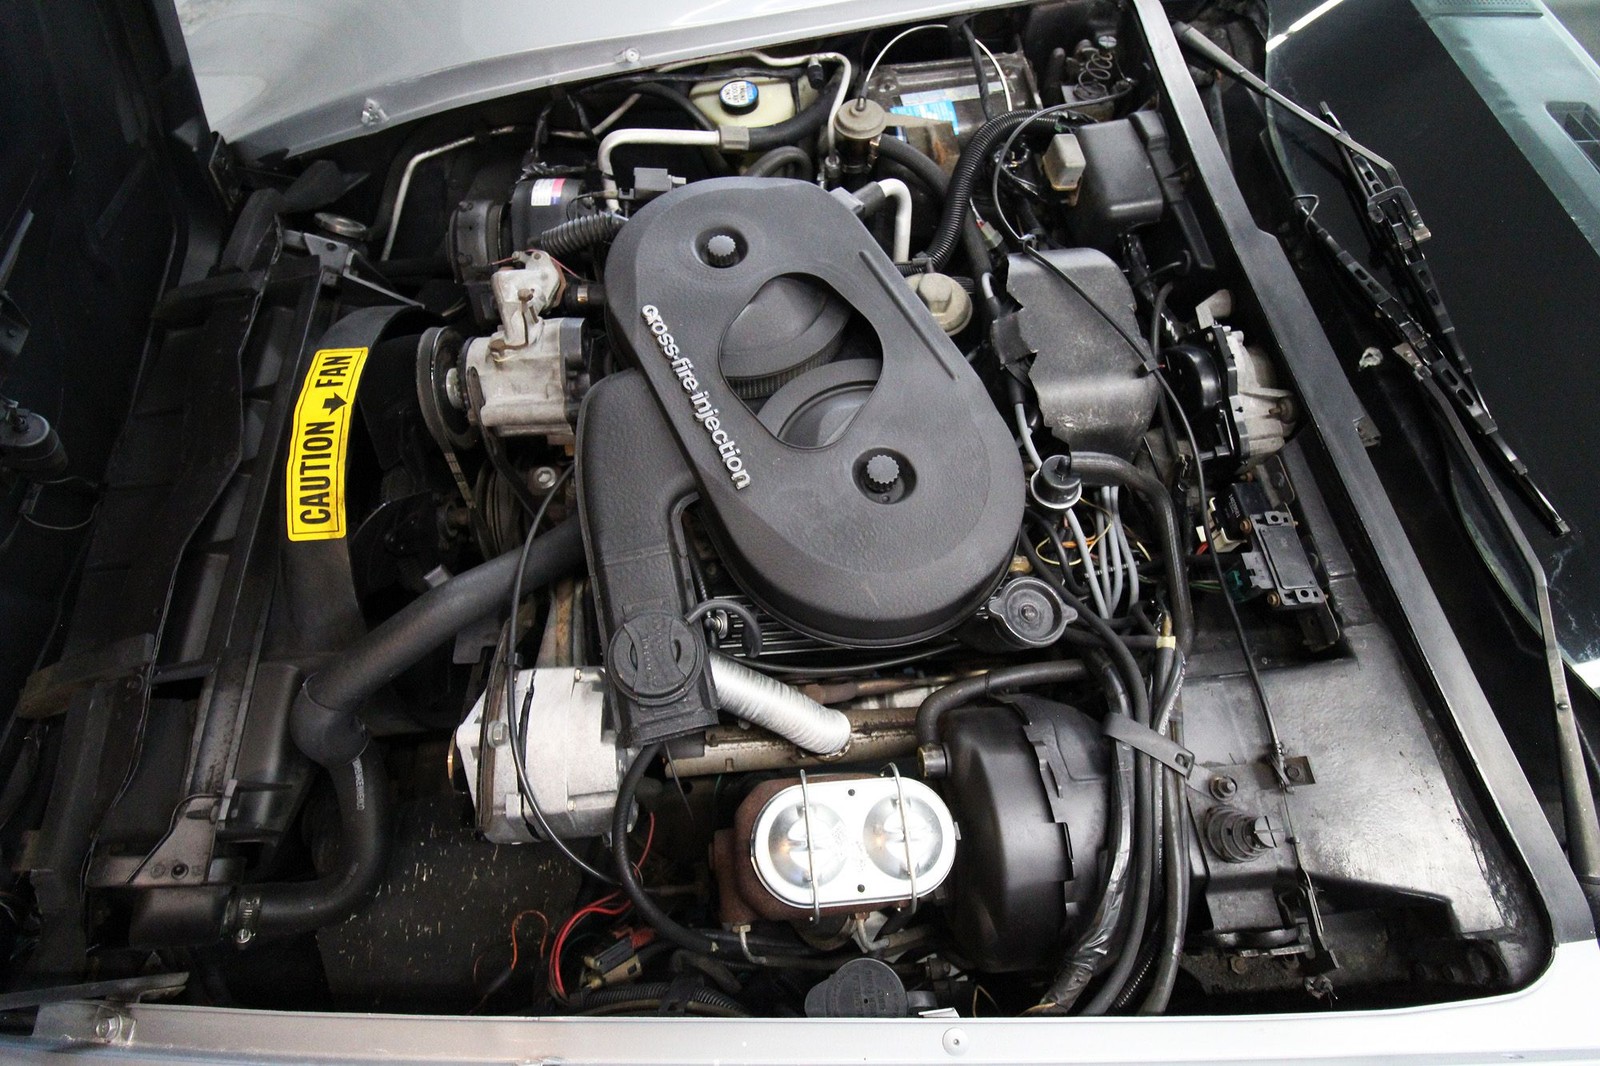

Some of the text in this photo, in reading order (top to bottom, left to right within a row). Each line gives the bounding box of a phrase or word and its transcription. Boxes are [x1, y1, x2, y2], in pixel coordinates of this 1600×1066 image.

[300, 355, 352, 525] CAUTION FAN
[690, 390, 751, 491] injection
